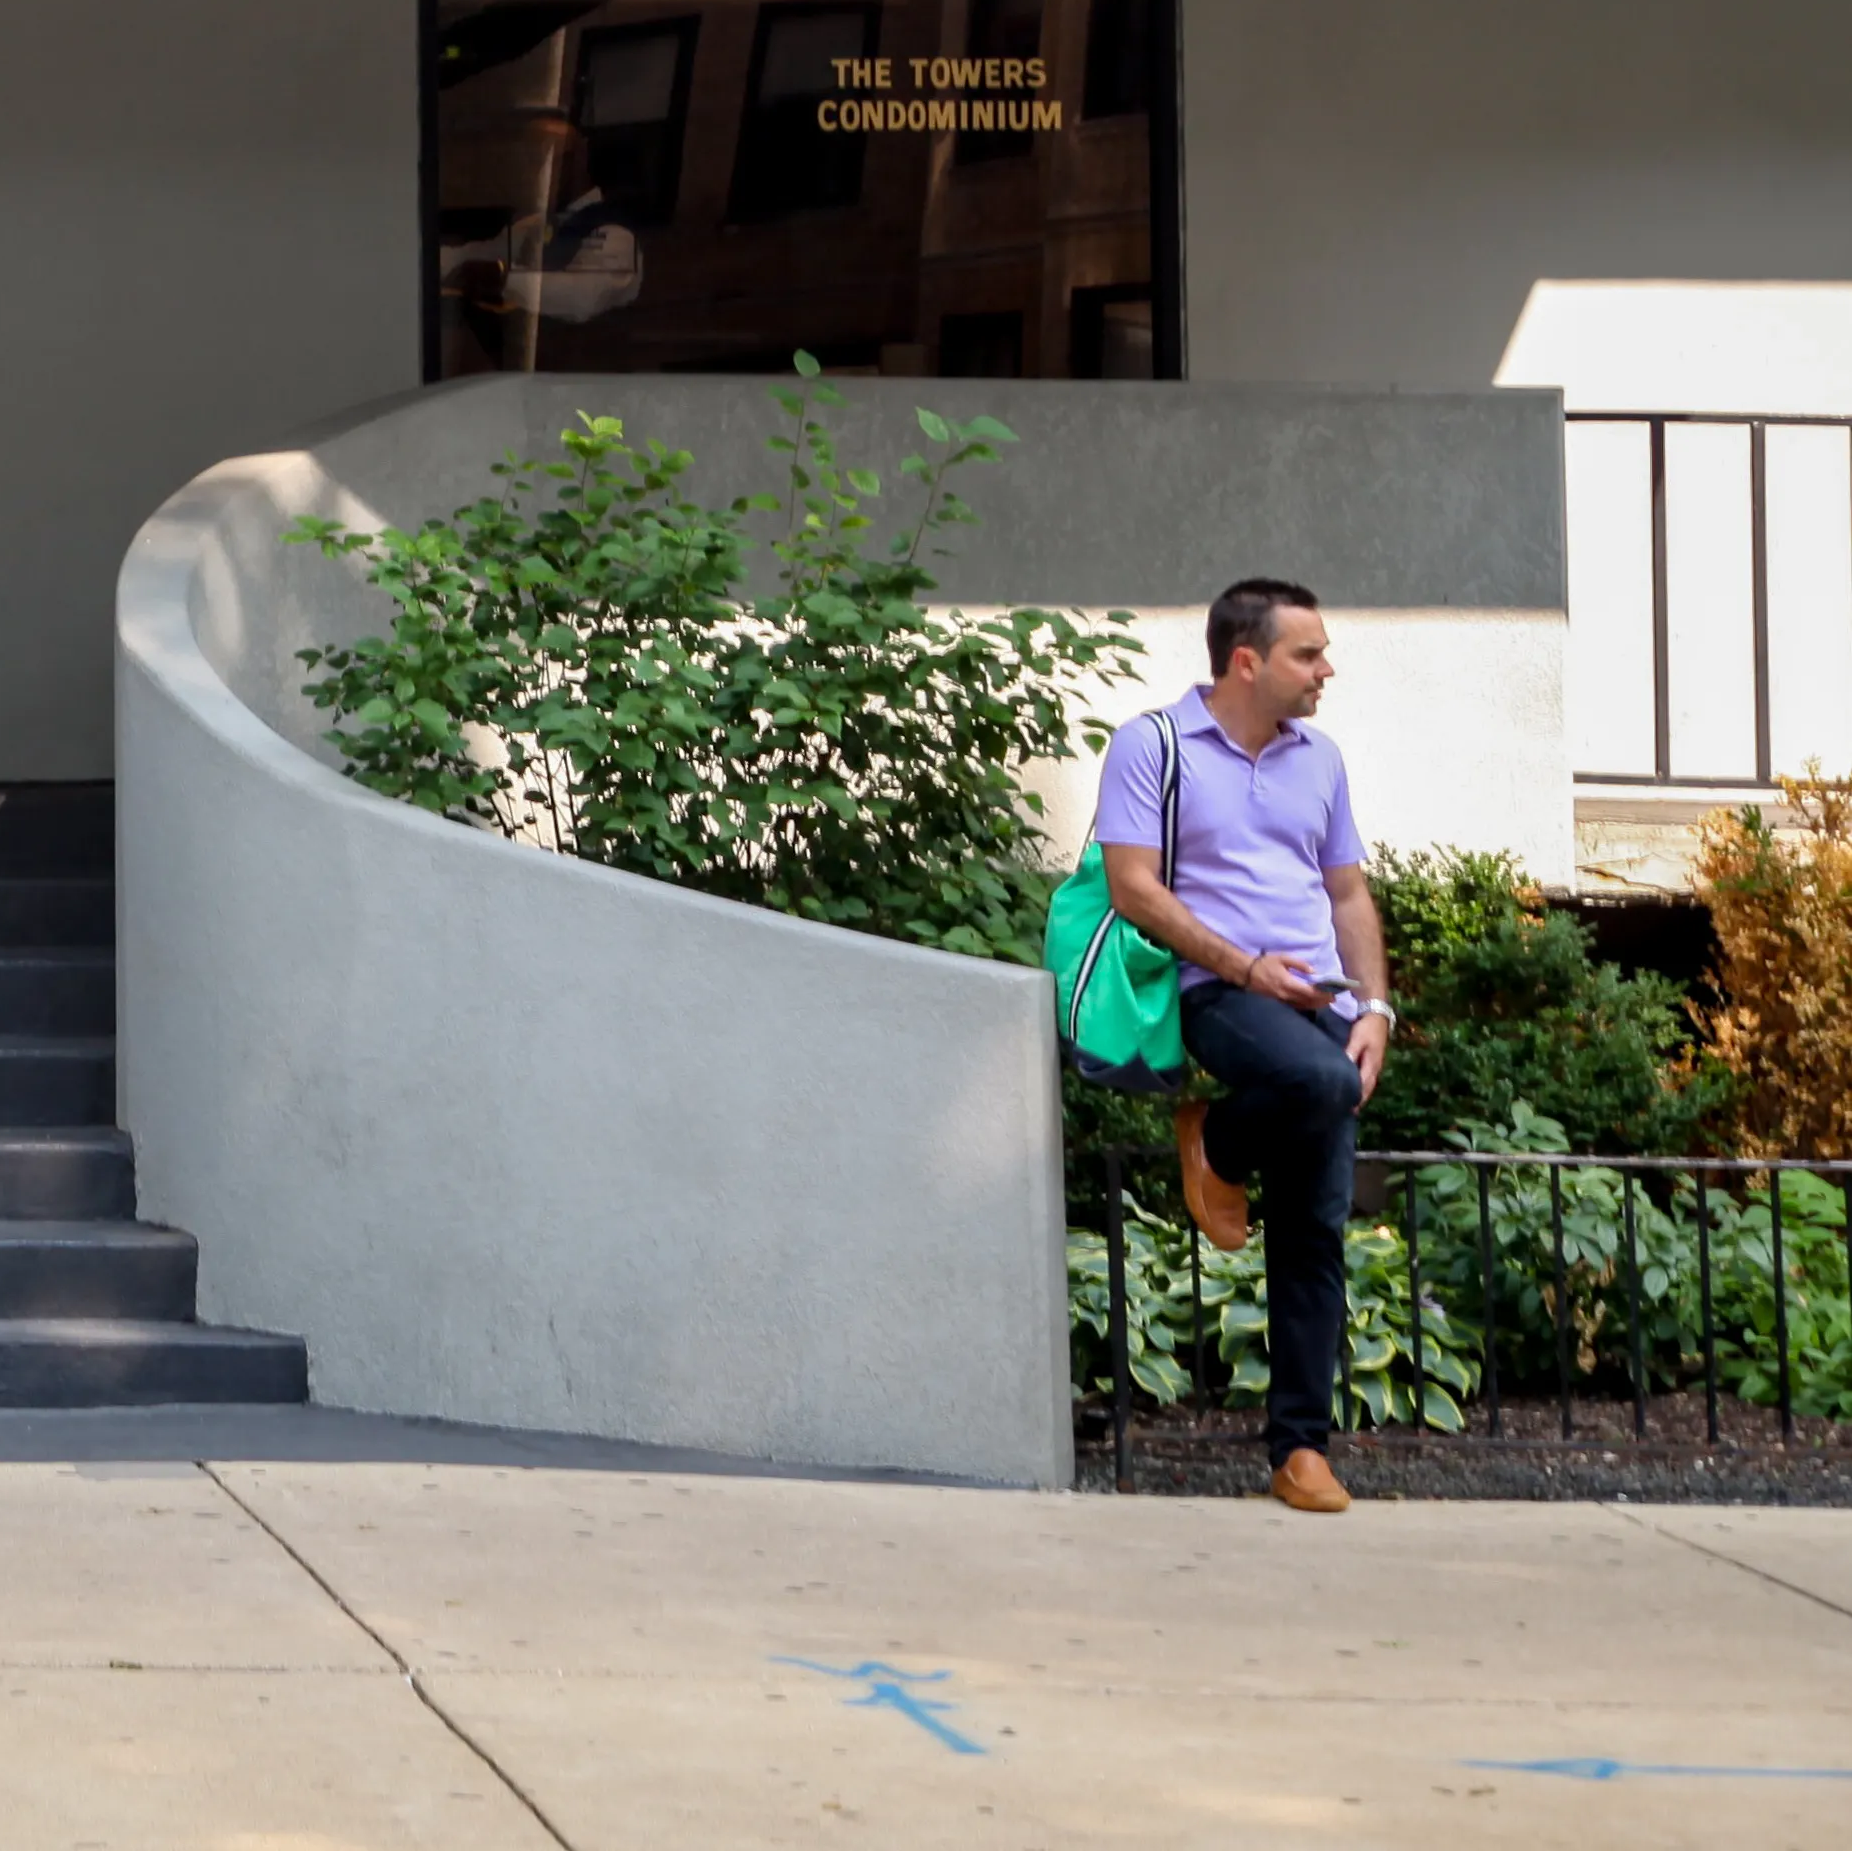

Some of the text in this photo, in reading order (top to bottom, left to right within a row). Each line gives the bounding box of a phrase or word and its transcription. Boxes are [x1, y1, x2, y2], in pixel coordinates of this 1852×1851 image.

[831, 57, 1047, 90] THE TOWERS
[817, 99, 1062, 131] CONDOMINIUM
